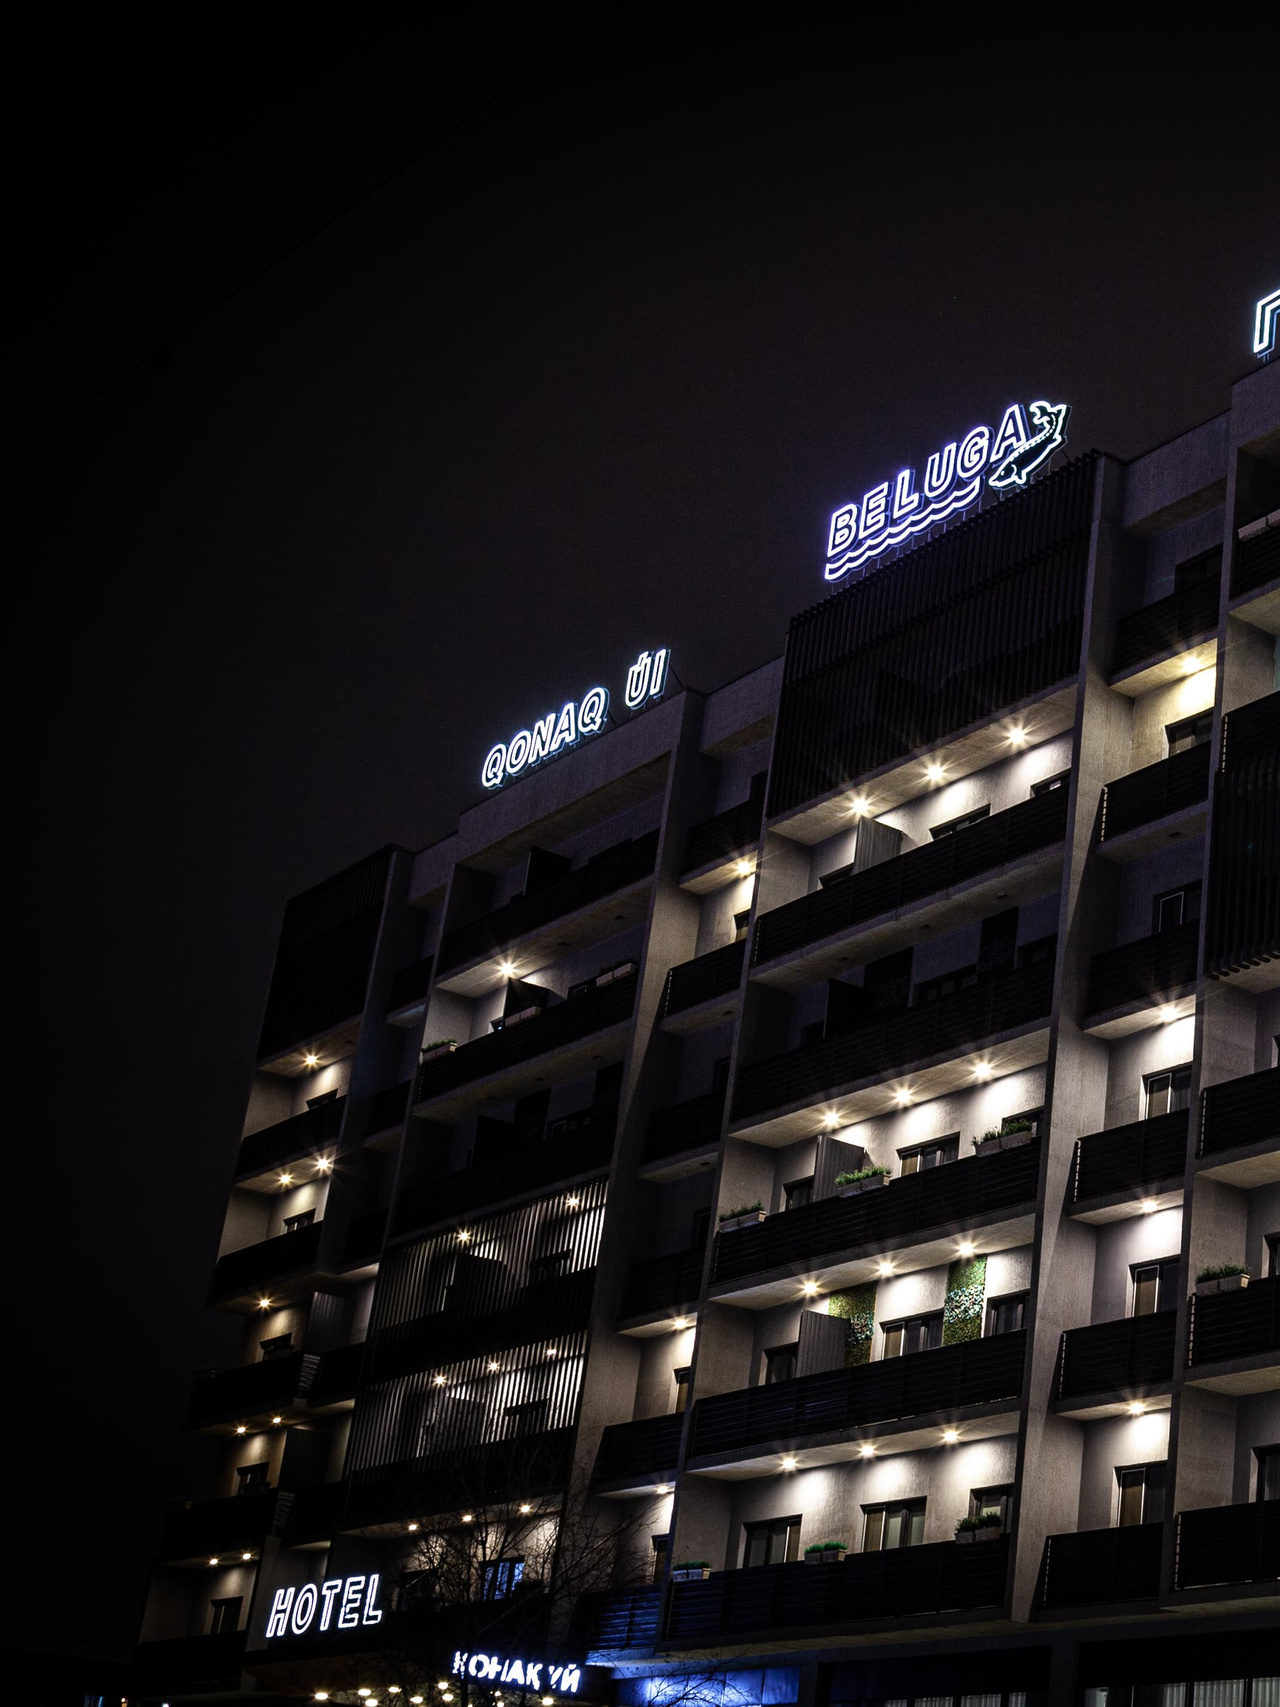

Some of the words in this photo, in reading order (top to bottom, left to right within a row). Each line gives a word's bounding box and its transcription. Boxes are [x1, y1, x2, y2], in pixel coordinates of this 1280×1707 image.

[827, 404, 1032, 559] BELUGA
[481, 686, 610, 790] QONAQ
[265, 1574, 383, 1638] HOTEL
